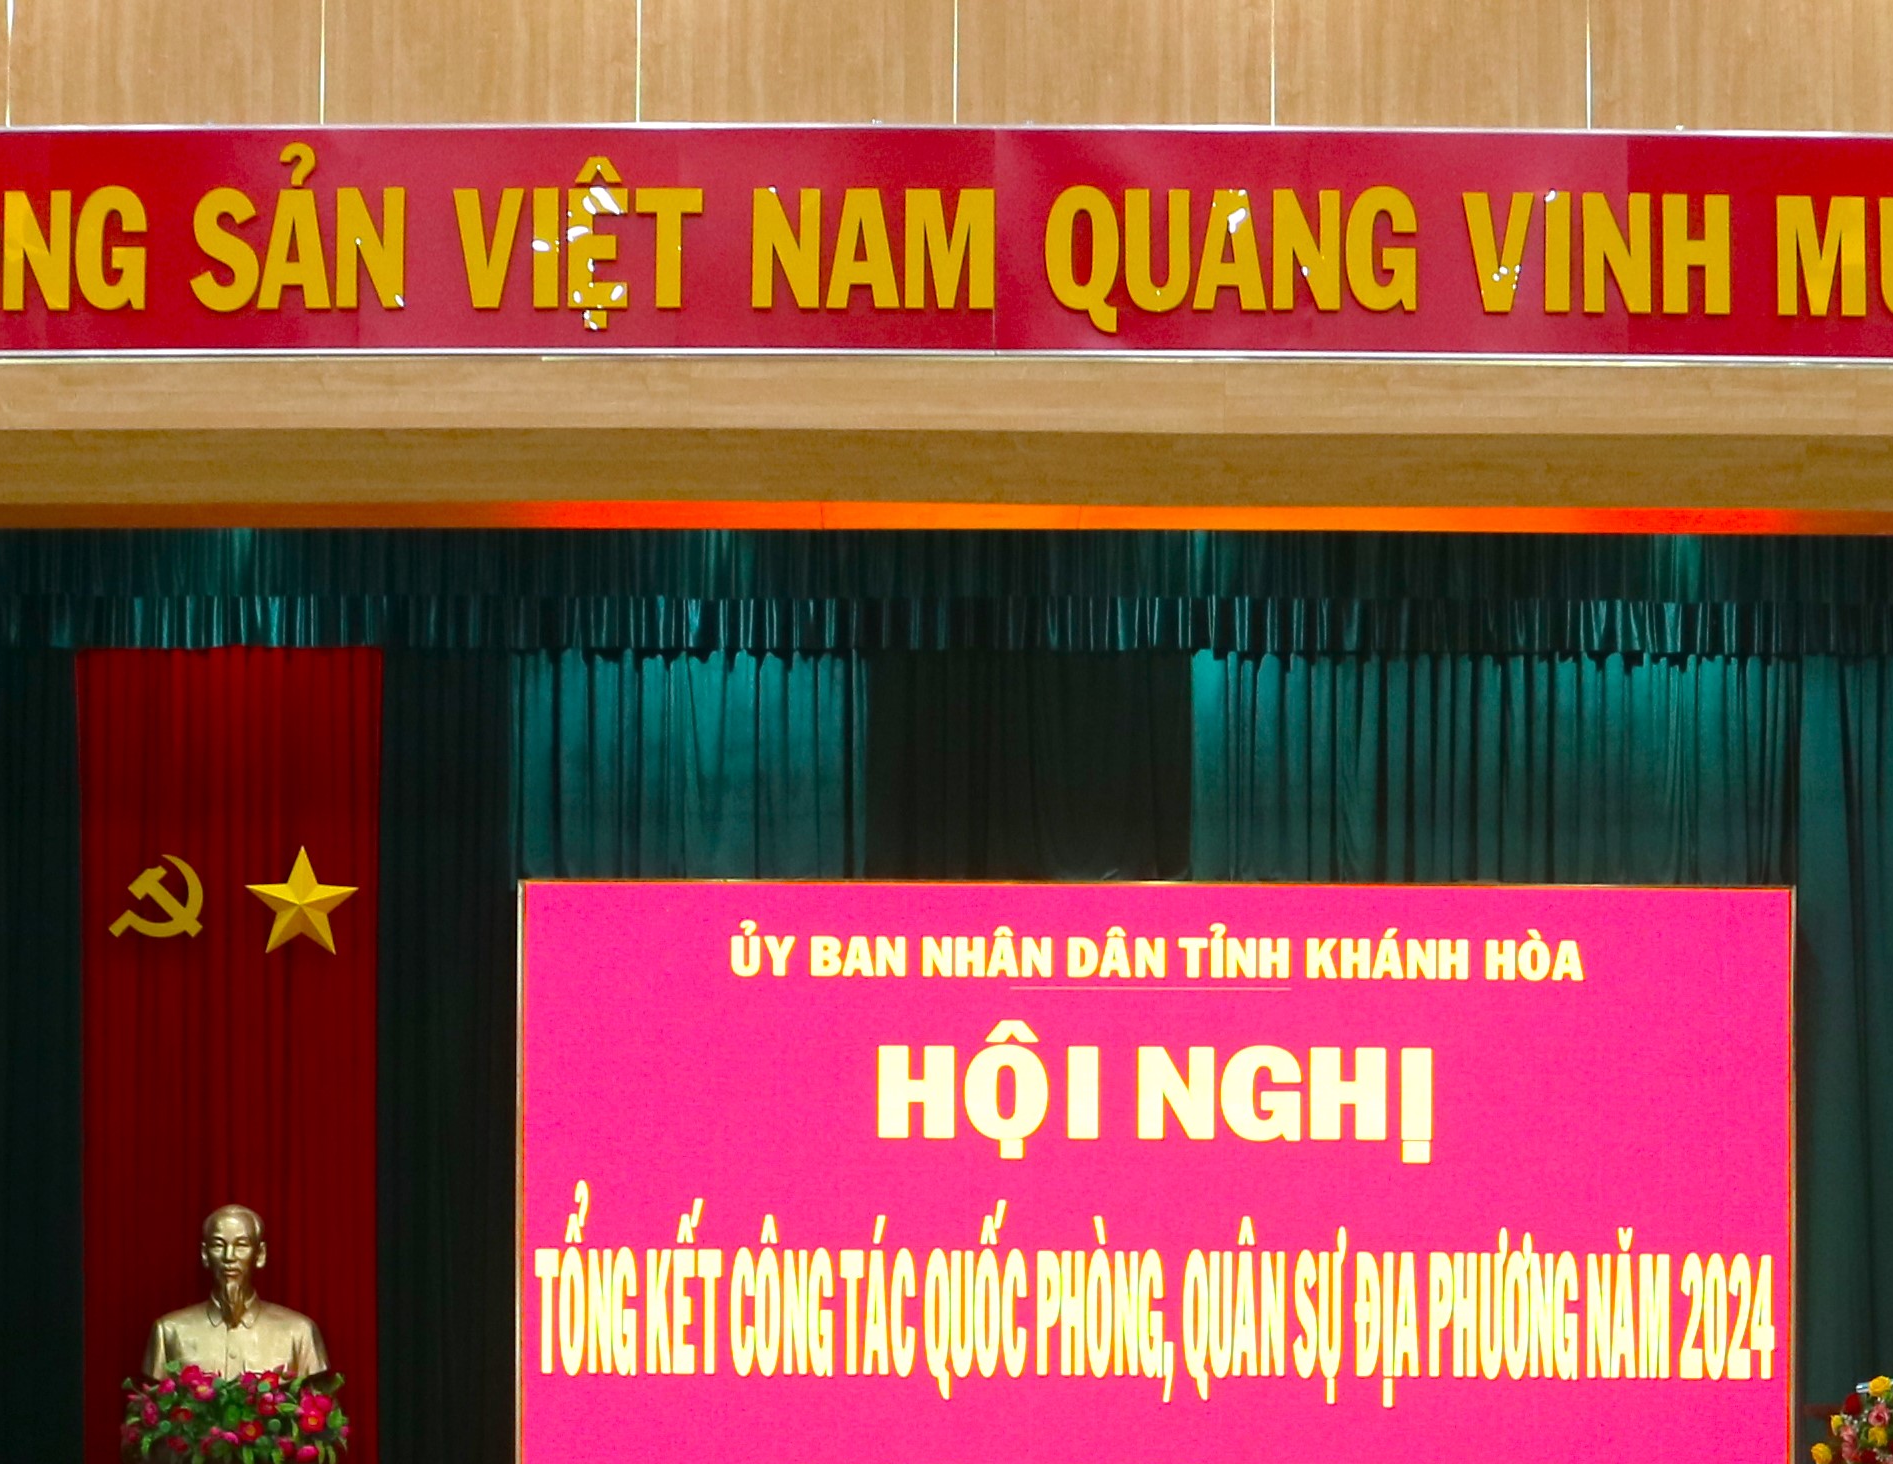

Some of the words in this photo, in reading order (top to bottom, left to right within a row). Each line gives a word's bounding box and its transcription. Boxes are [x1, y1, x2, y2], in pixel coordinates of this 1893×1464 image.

[191, 143, 405, 311] SẢN
[453, 156, 703, 330] VIỆT
[752, 187, 995, 309] NAM
[1045, 186, 1417, 332] QUANG
[1463, 190, 1730, 314] VINH
[731, 920, 795, 976] ỦY
[811, 936, 906, 976] BAN
[922, 926, 1052, 977] NHÂN
[1067, 926, 1166, 978] DÂN
[1178, 923, 1290, 978] TỈNH
[1306, 928, 1469, 980] KHÁNH
[1485, 929, 1584, 981] HÒA
[878, 1020, 1099, 1159] HỘI
[1138, 1045, 1432, 1163] NGHỊ
[535, 1180, 637, 1376] TỔNG
[646, 1198, 722, 1374] KẾT
[730, 1214, 834, 1376] CÔNG
[840, 1215, 916, 1377] TÁC
[924, 1200, 1027, 1399] QUỐC
[1037, 1216, 1174, 1402] PHÒNG,
[1183, 1216, 1286, 1400] QUÂN
[1293, 1226, 1347, 1404] SỰ
[1354, 1252, 1419, 1407] ĐỊA
[1429, 1228, 1578, 1380] PHƯƠNG
[1587, 1227, 1670, 1378] NĂM
[1679, 1253, 1775, 1380] 2024
